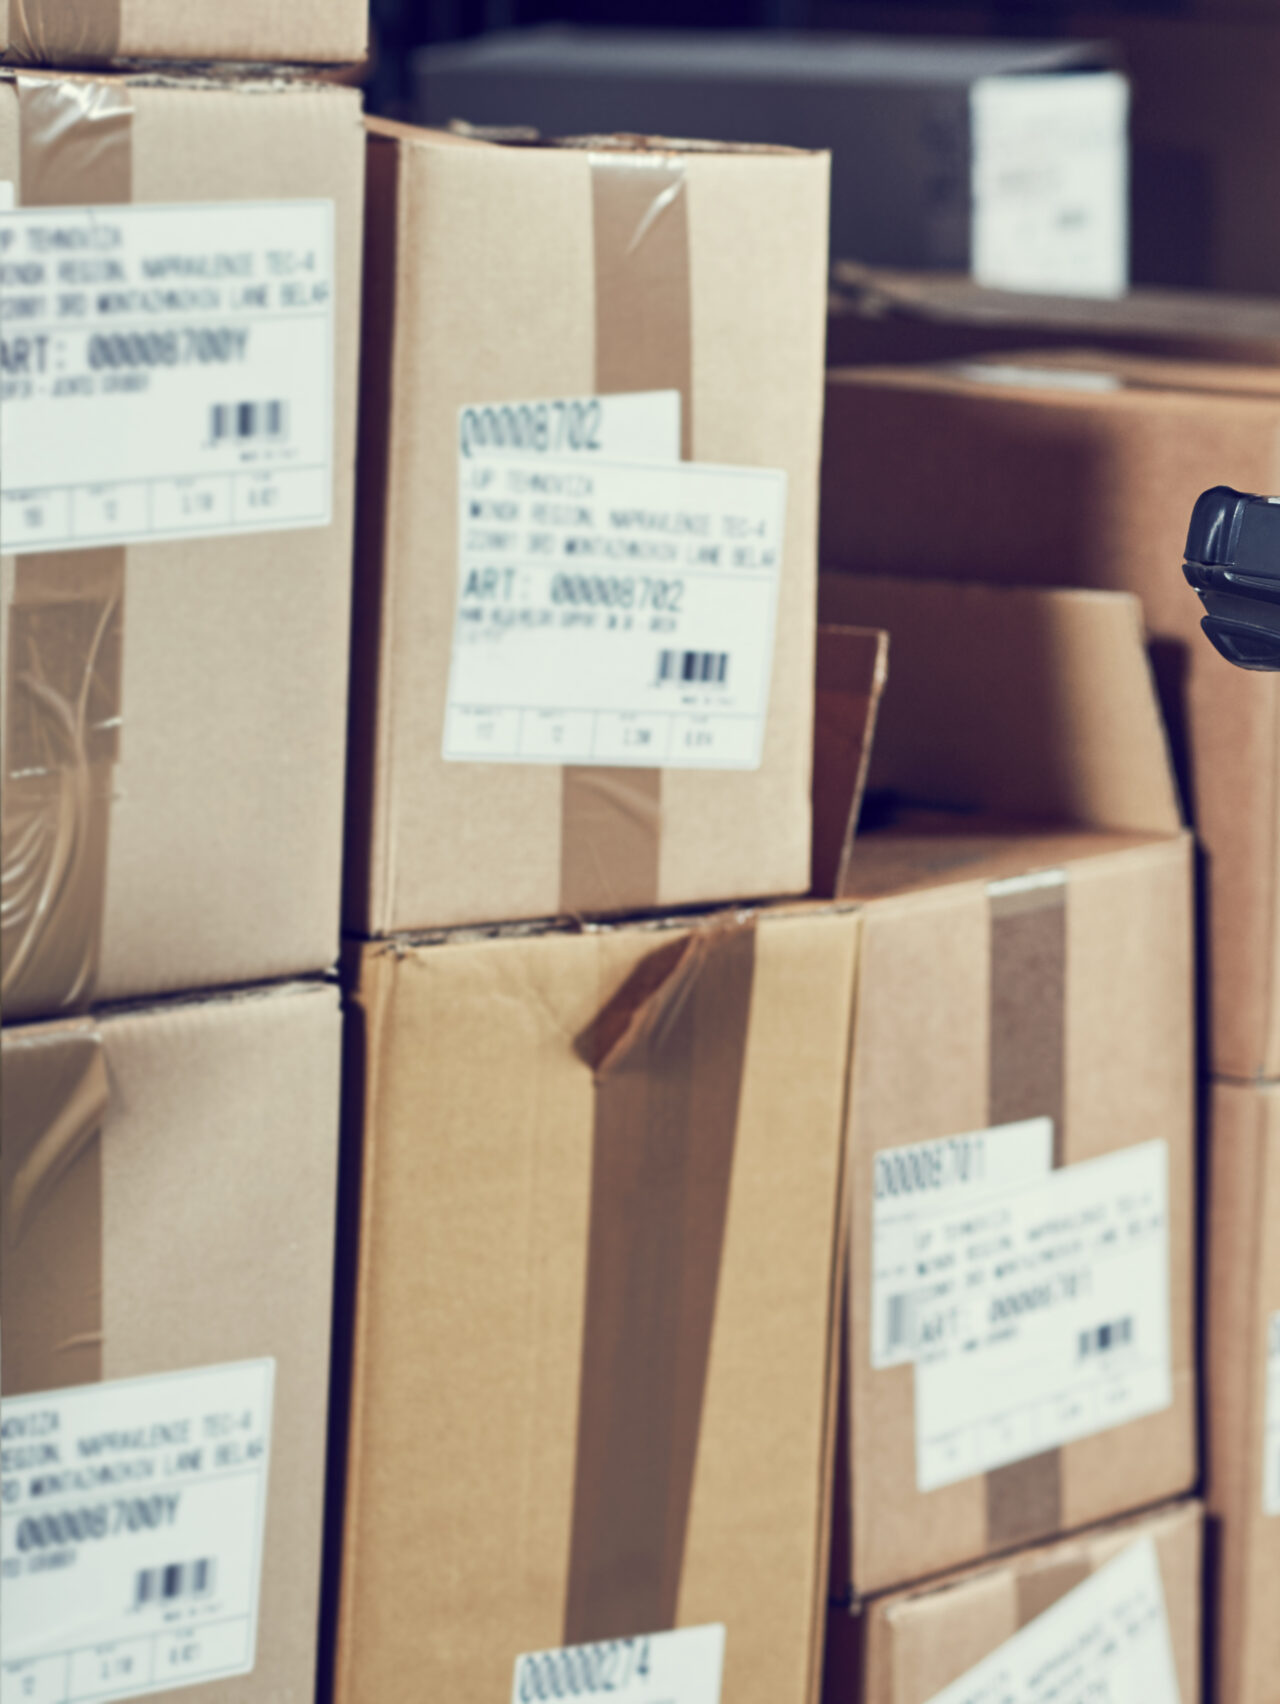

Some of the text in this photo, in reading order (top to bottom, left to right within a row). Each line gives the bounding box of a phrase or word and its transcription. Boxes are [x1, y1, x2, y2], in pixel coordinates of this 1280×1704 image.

[461, 399, 601, 458] 00008702
[463, 566, 685, 612] ART: 00008702
